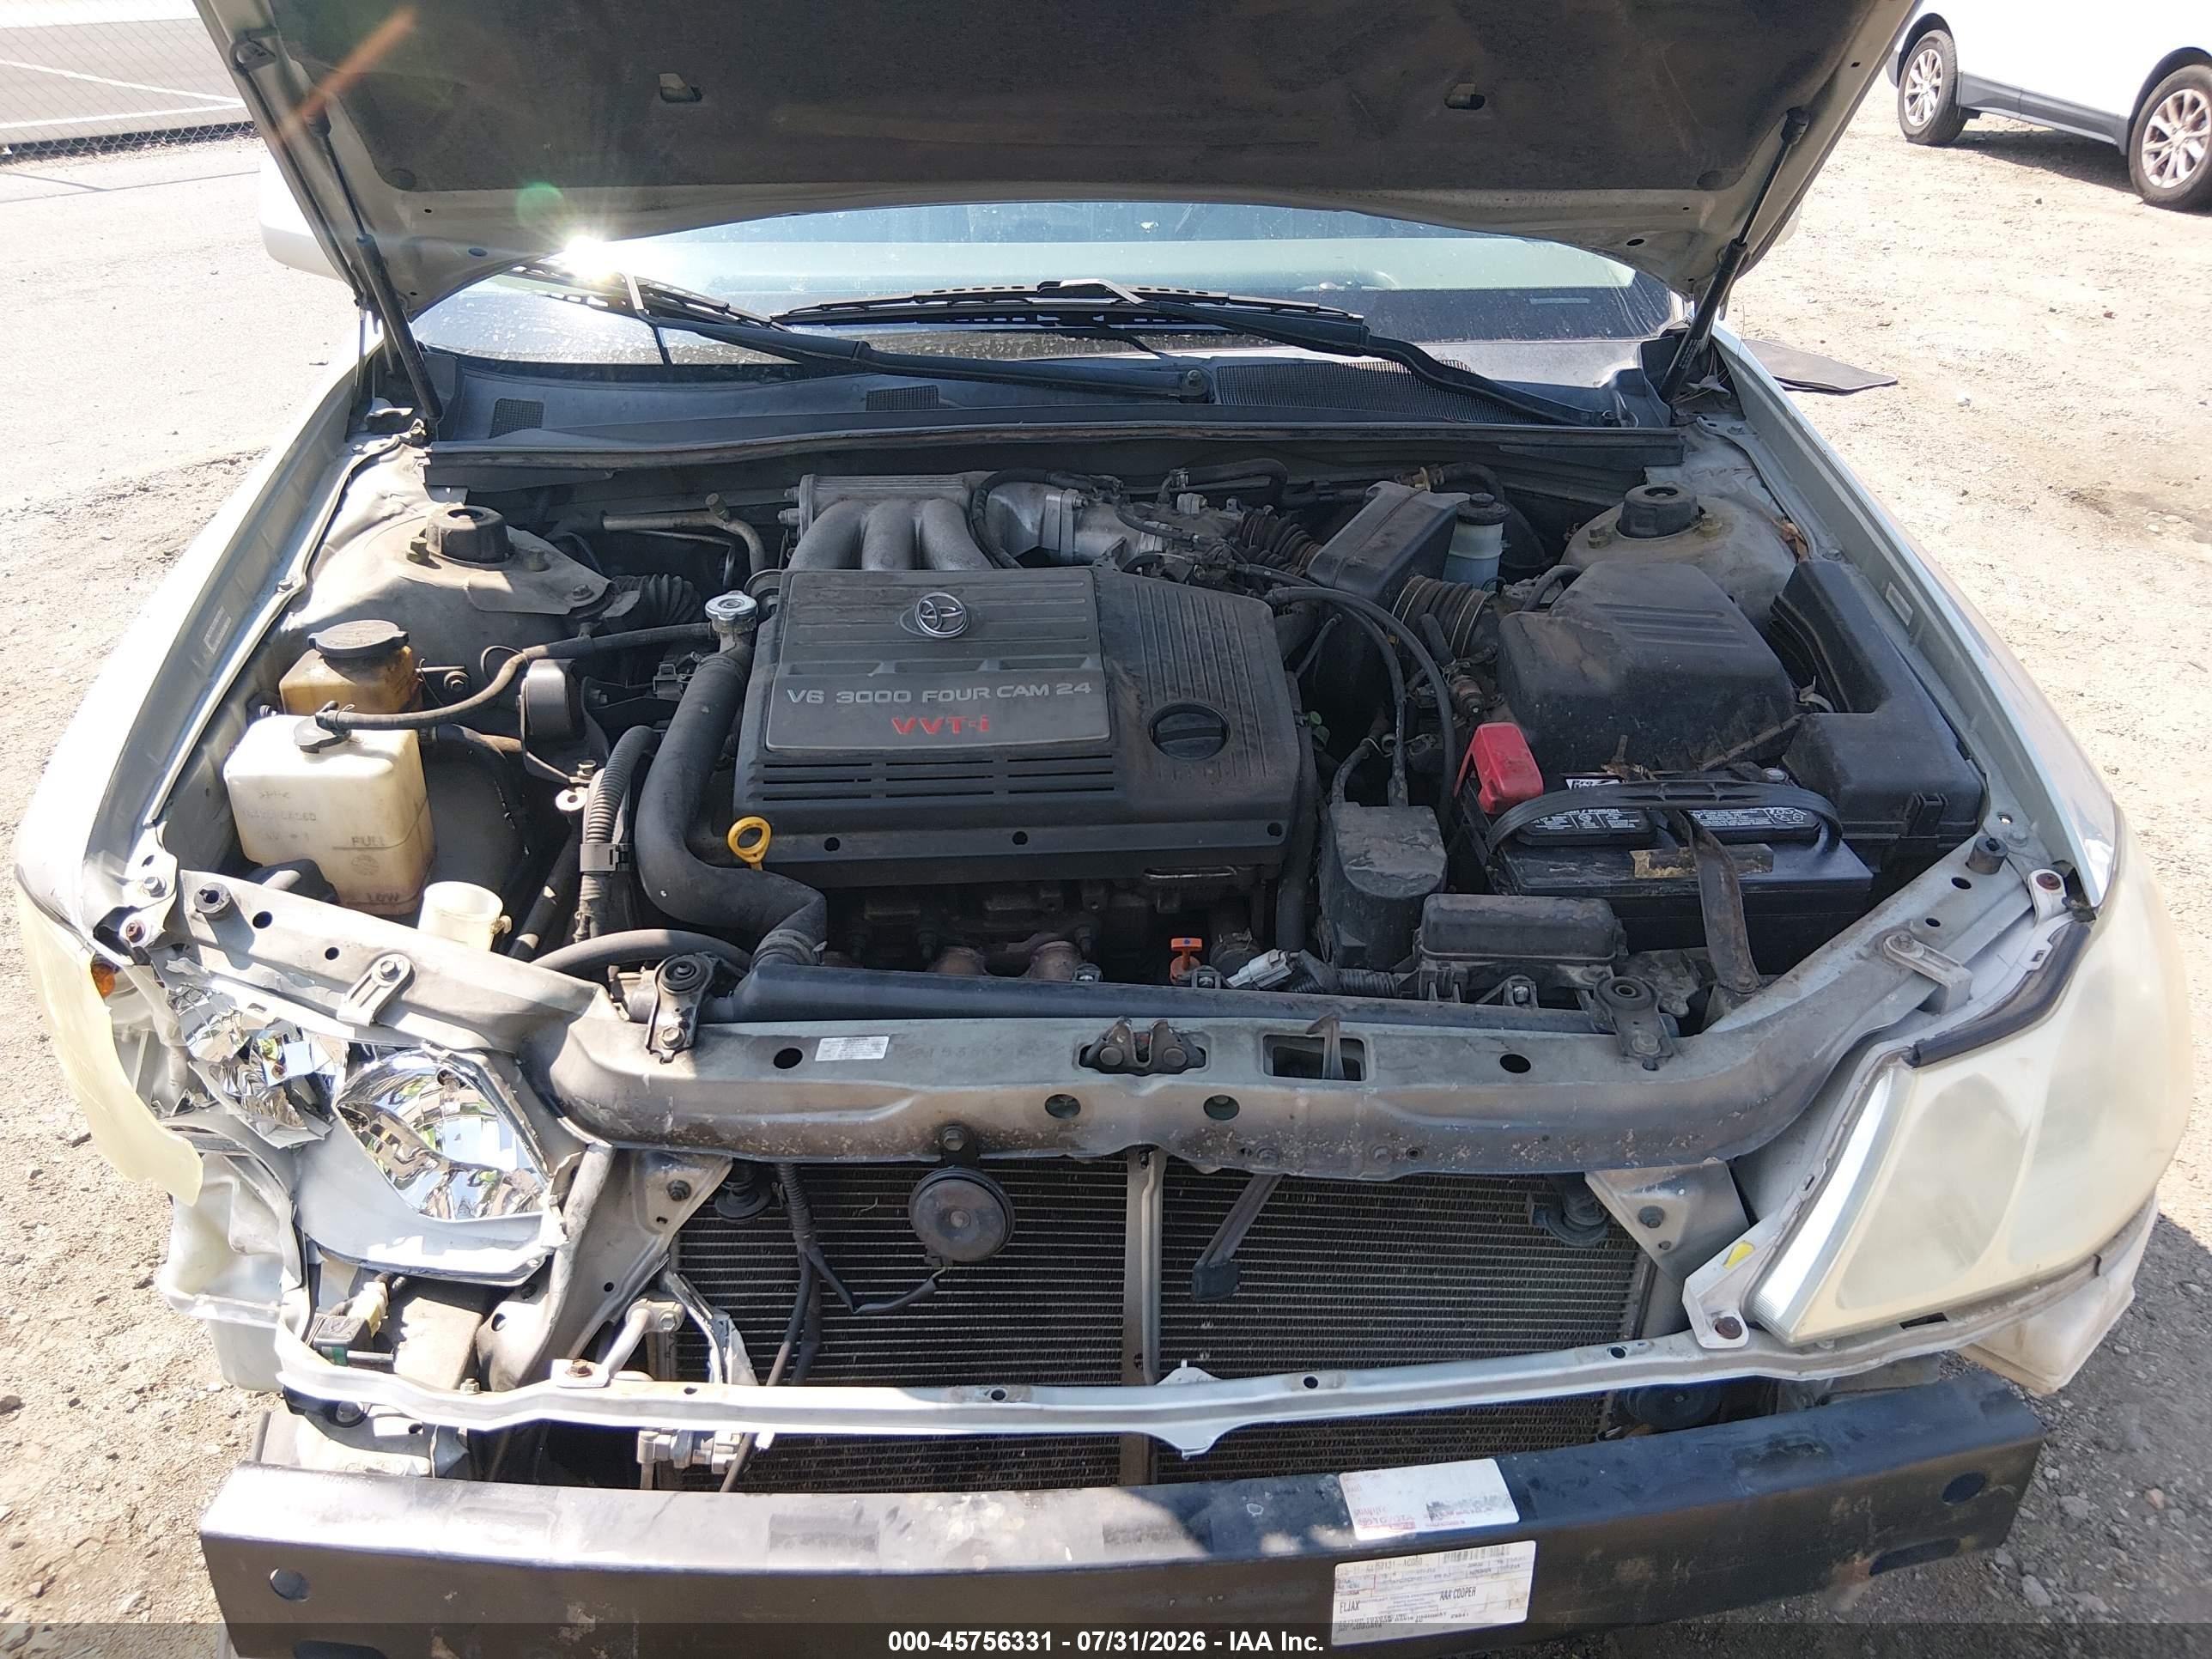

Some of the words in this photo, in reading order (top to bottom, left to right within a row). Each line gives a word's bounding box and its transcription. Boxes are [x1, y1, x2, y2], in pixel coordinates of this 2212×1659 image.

[787, 688, 825, 704] V6
[836, 690, 912, 704] 3000
[921, 686, 991, 703] FOUR
[996, 683, 1049, 699] CAM
[1055, 682, 1092, 696] 24
[891, 714, 989, 735] VVT-i
[350, 835, 385, 847] FULL
[367, 892, 399, 902] LOW
[1453, 1586, 1477, 1600] COOPER
